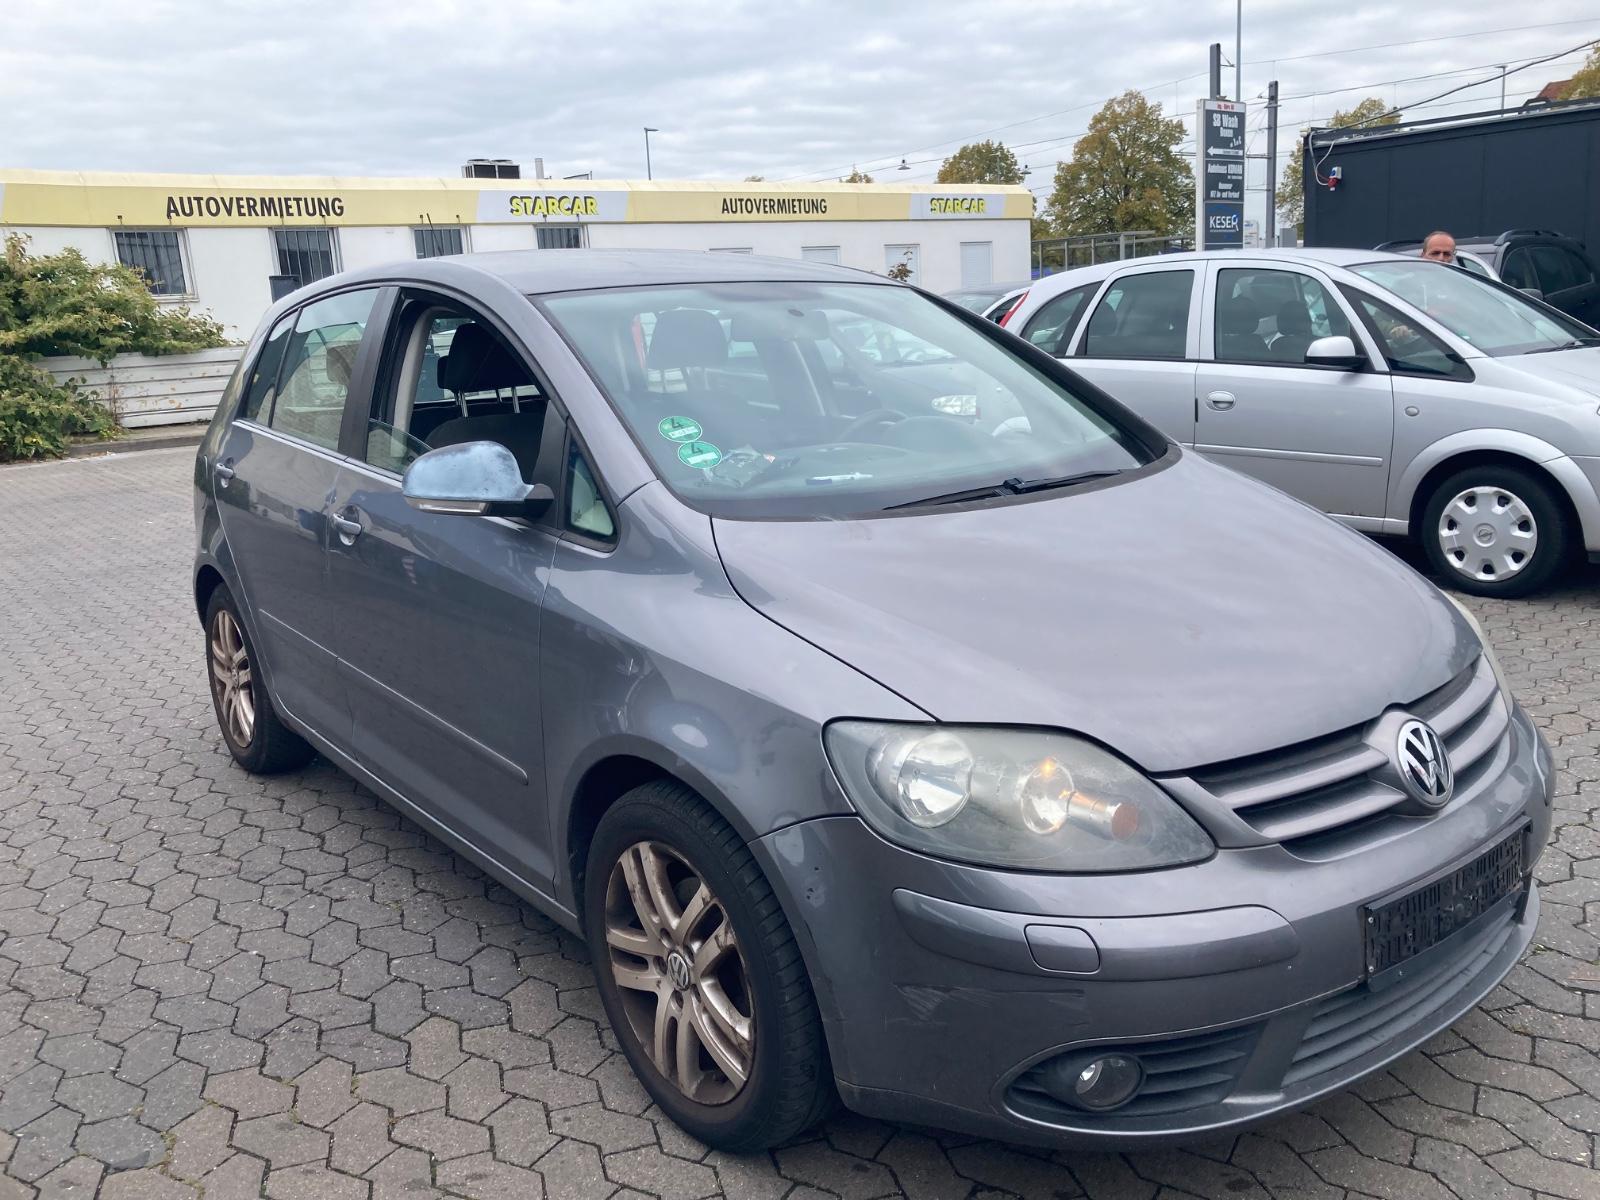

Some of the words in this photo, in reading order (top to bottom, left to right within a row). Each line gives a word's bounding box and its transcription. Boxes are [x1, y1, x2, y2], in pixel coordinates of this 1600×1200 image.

[1222, 114, 1239, 128] Wash
[166, 196, 345, 218] AUTOVERMIETUNG
[509, 194, 600, 216] STARCAR
[721, 197, 828, 214] AUTOVERMIETUNG
[929, 197, 986, 214] STARCAR
[1209, 214, 1239, 232] KESER
